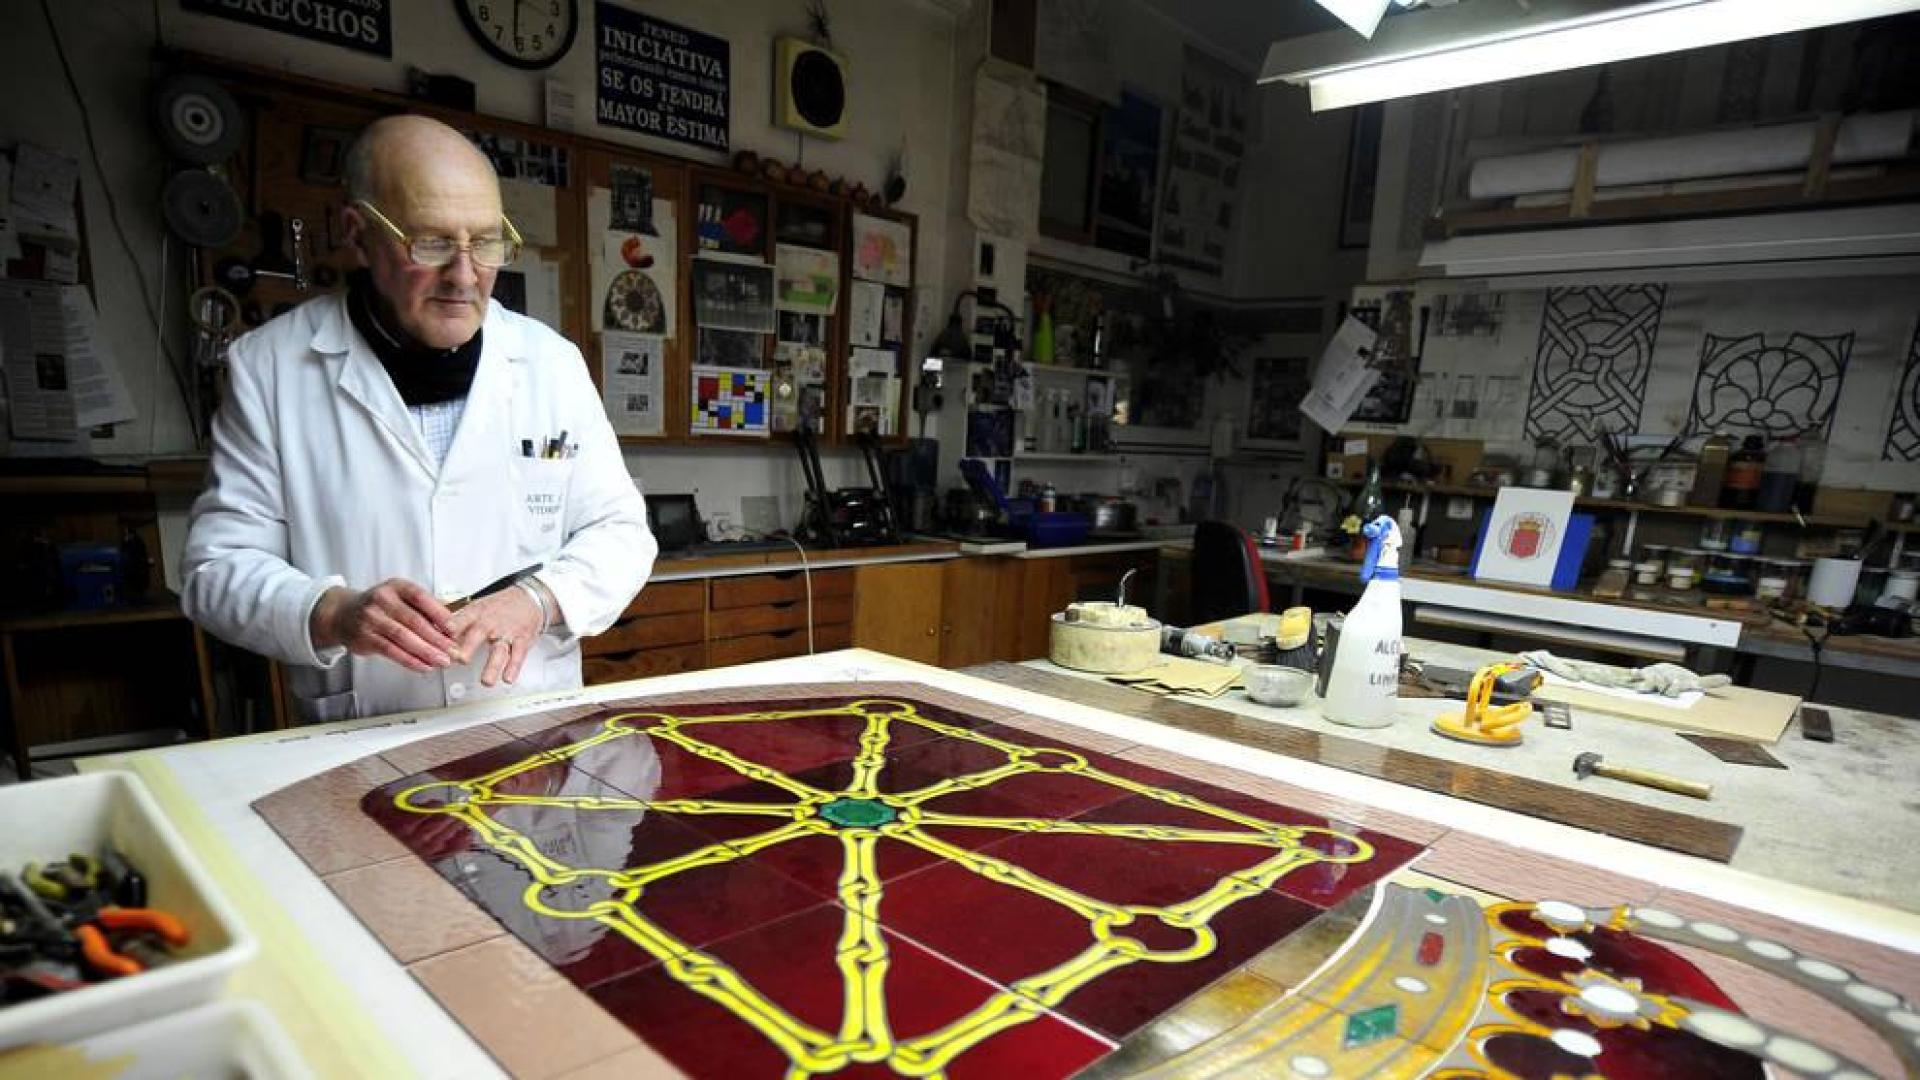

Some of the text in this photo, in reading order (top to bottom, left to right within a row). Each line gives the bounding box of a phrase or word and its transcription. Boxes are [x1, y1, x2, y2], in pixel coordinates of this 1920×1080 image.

[203, 0, 378, 43] RECHOS
[479, 6, 488, 21] 8
[494, 25, 503, 40] 7
[532, 35, 541, 51] 5
[603, 25, 722, 78] INICIATIVA
[601, 66, 624, 90] SE
[629, 74, 653, 98] OS
[598, 97, 661, 131] MAYOR
[666, 115, 728, 147] ESTIMA
